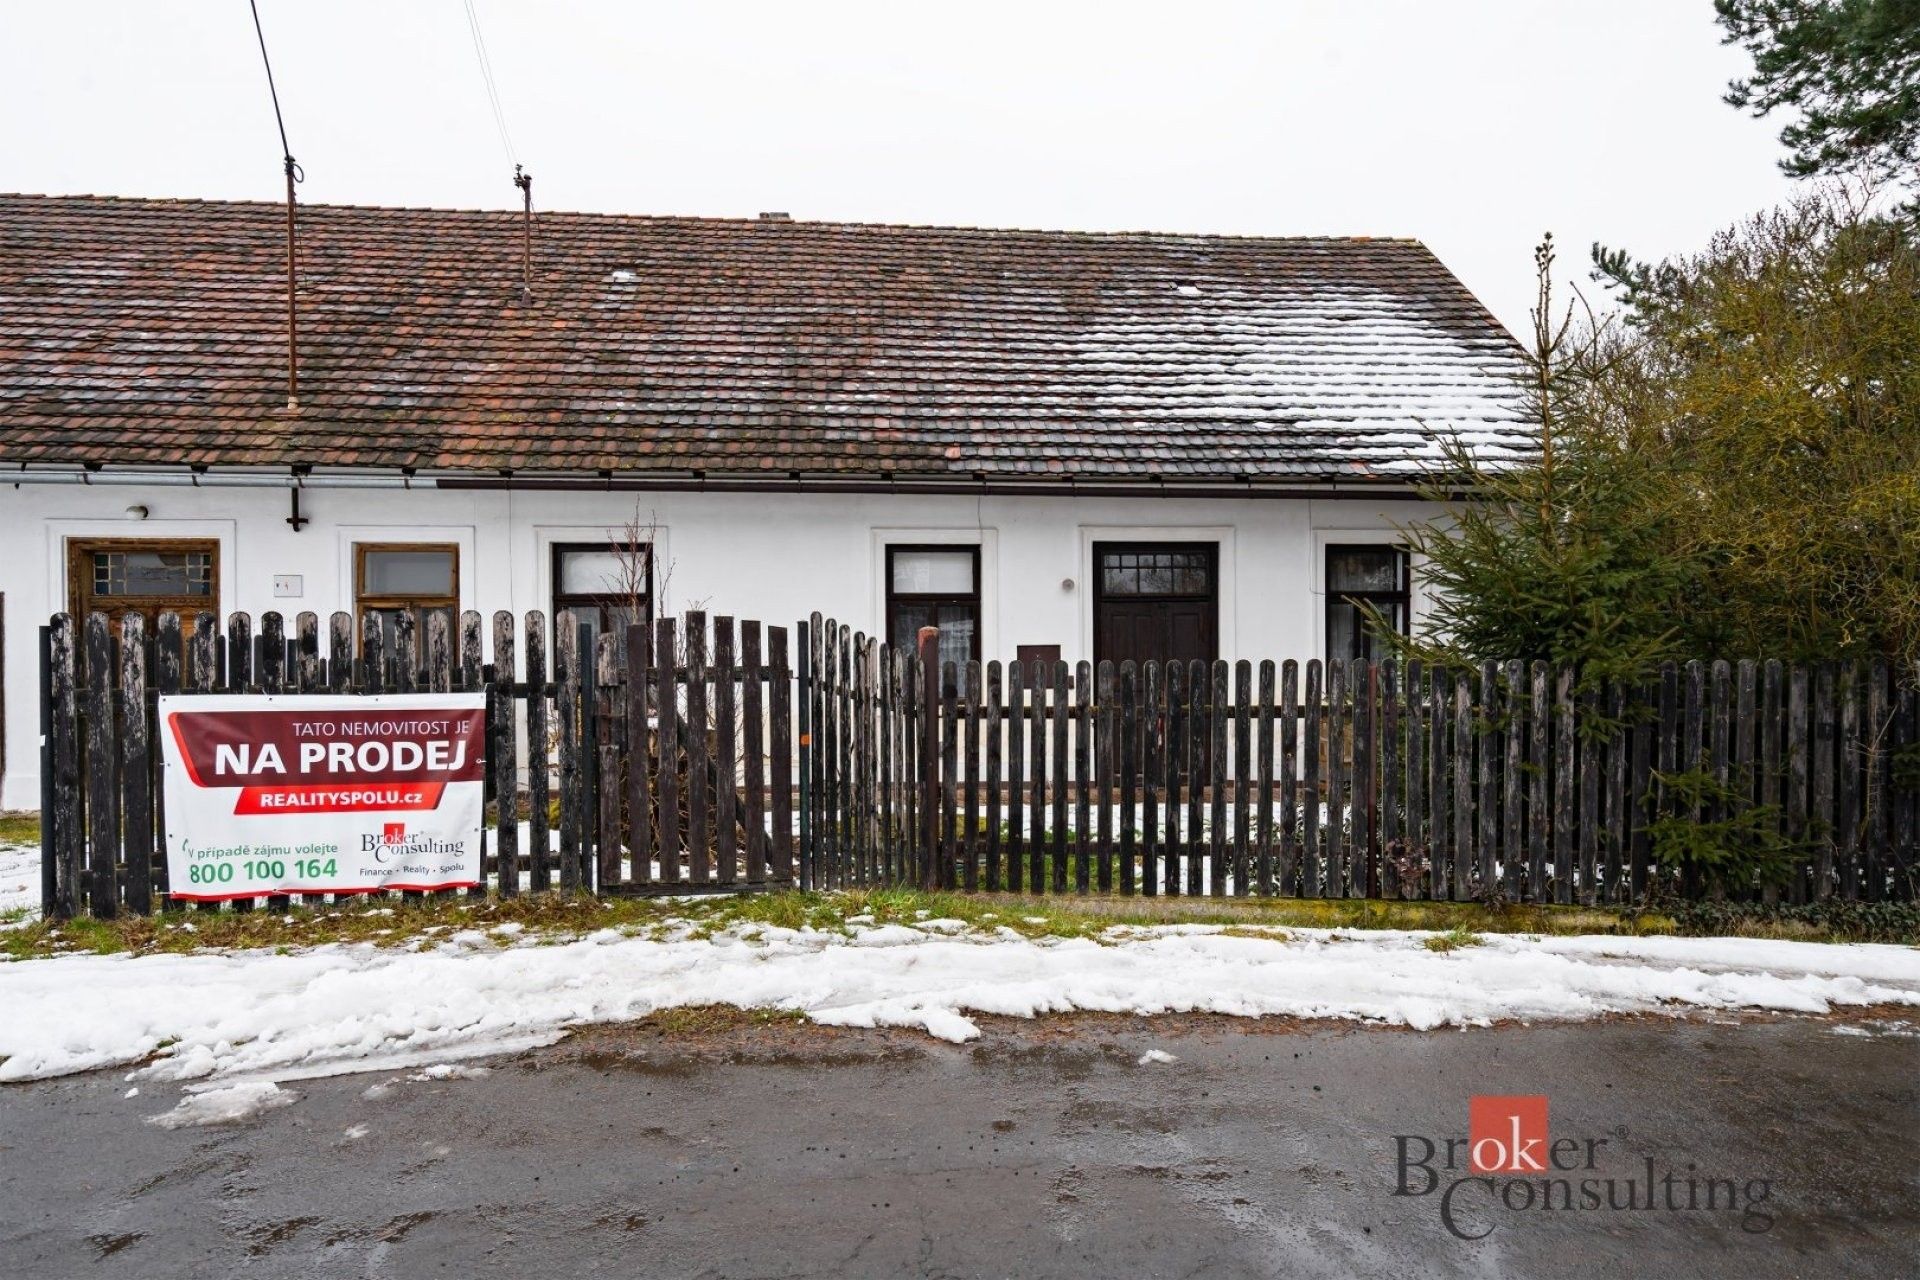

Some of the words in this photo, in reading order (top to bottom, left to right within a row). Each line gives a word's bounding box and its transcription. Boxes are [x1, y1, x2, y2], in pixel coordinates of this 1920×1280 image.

[293, 722, 336, 737] TATO
[341, 720, 449, 736] NEMOVITOST
[454, 720, 470, 735] JE
[215, 743, 287, 775] NA
[300, 740, 467, 773] PRODEJ
[260, 791, 423, 808] REALITYSPOLU.cz
[361, 827, 419, 852] Broker
[197, 845, 250, 861] případě
[254, 844, 291, 857] zájmu
[294, 843, 339, 855] volejte
[375, 838, 465, 863] Consulting
[190, 862, 234, 883] 800
[243, 860, 285, 880] 100
[294, 858, 338, 878] 164
[360, 868, 393, 876] Finance
[403, 865, 430, 875] Reality
